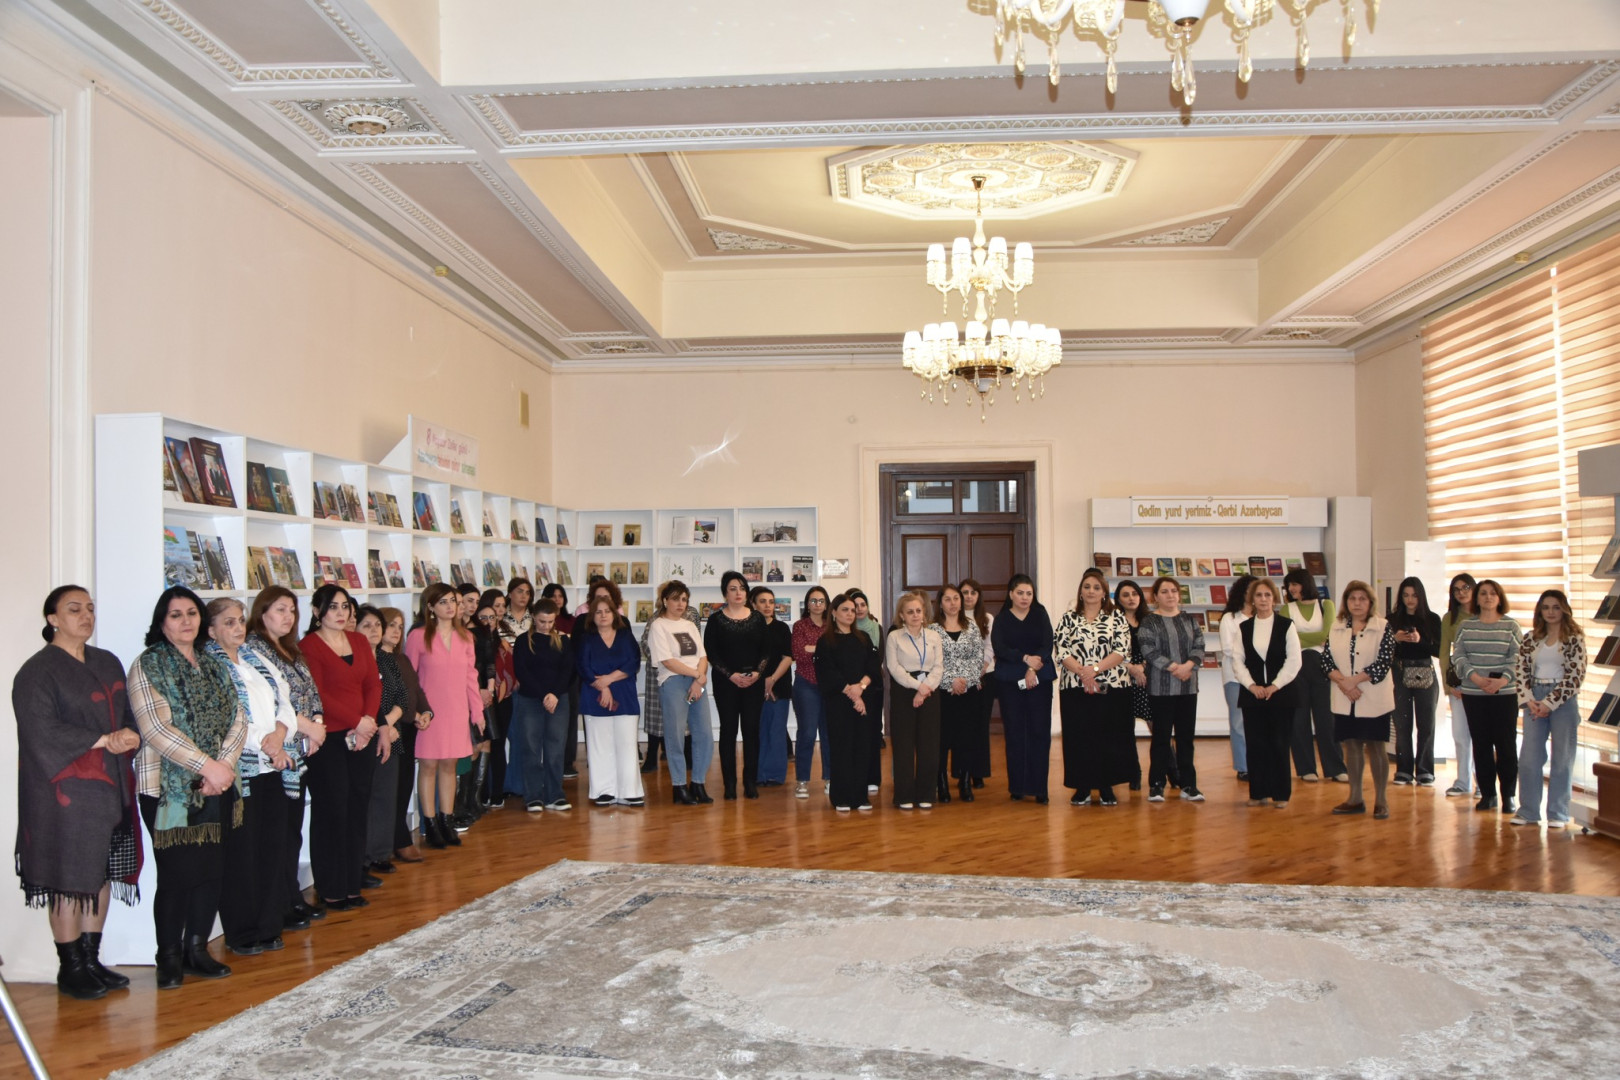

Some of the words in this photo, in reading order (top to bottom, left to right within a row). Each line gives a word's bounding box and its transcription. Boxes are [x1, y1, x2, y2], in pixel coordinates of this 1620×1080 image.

[1138, 504, 1161, 518] Qədim
[1165, 504, 1182, 520] yurd
[1185, 504, 1212, 520] yerimiz
[1217, 504, 1237, 517] Qərbi
[1240, 504, 1283, 520] Azərbaycan
